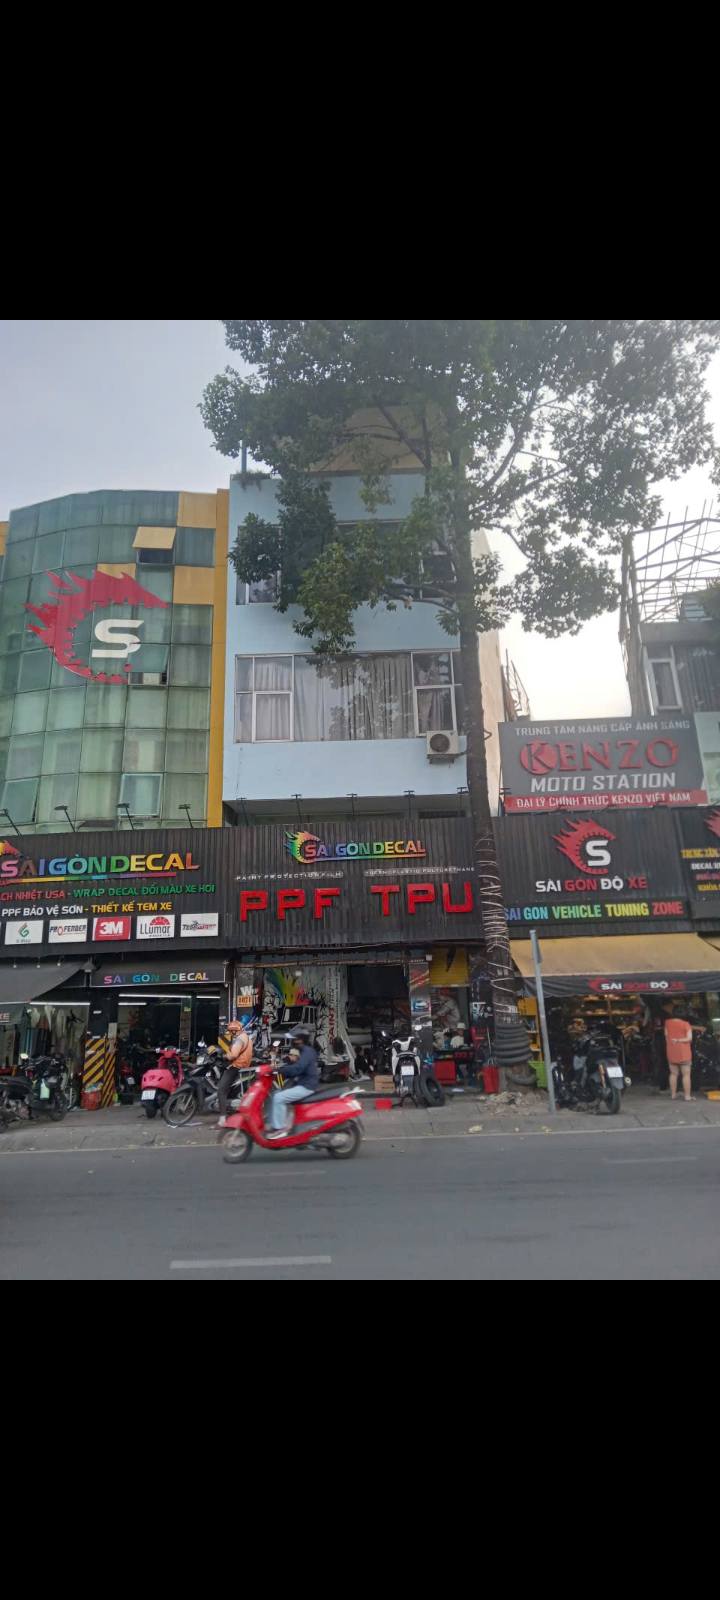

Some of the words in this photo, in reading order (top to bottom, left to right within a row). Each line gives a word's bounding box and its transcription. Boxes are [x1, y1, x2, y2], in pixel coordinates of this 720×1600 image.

[519, 737, 680, 775] KENZO
[531, 776, 585, 793] MOTO
[592, 772, 676, 791] STATION
[669, 791, 690, 802] NAM
[45, 890, 65, 899] USA
[73, 889, 105, 897] WRAP
[109, 887, 138, 896] DECAL
[2, 908, 21, 917] PPF
[137, 902, 158, 911] TEM
[160, 902, 173, 910] XE
[239, 888, 342, 922] PPF
[369, 882, 474, 916] TPU
[552, 905, 602, 919] VEHICLE
[606, 903, 649, 917] TUNING
[652, 901, 684, 915] ZONE
[100, 921, 124, 935] 3M
[169, 972, 209, 982] DECAL
